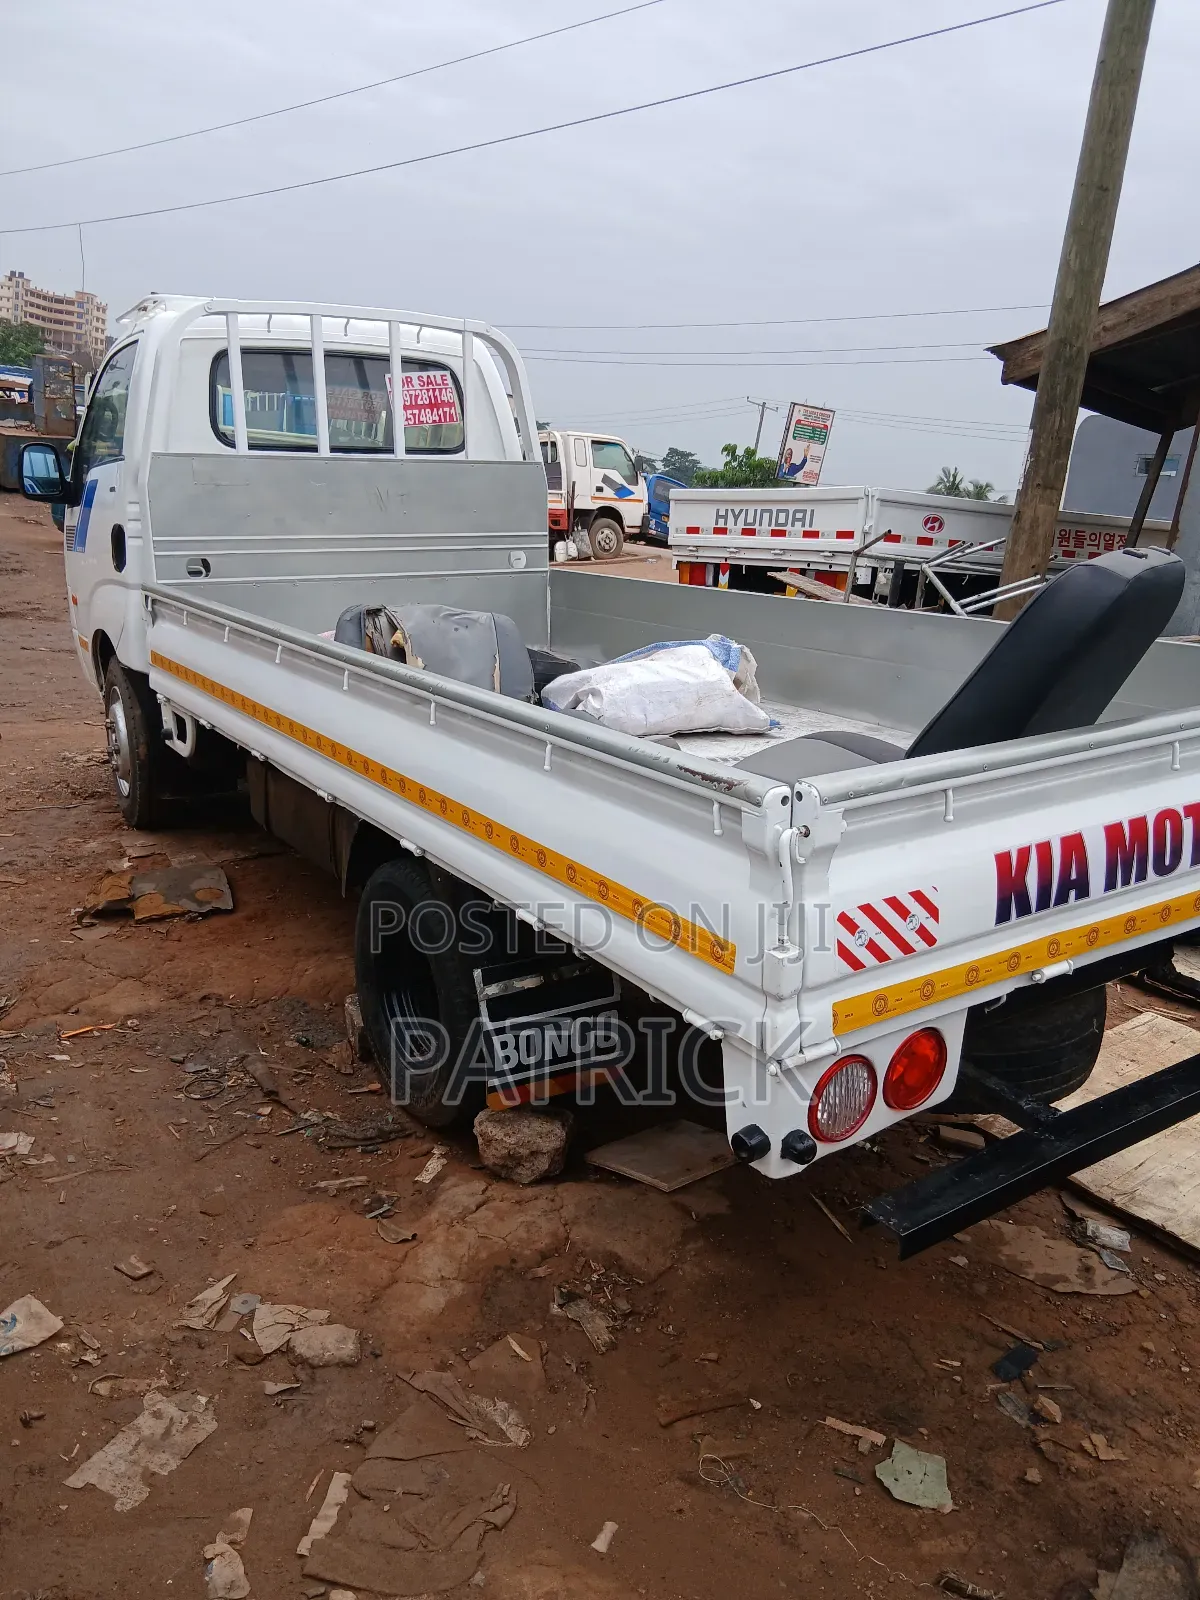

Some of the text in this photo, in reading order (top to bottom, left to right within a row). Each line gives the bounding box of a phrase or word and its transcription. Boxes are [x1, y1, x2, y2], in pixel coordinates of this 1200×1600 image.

[417, 374, 449, 388] SALE
[402, 388, 454, 406] 97281146
[714, 508, 815, 528] HYUNDAI
[994, 831, 1091, 926] KIA
[493, 1010, 619, 1072] BONGO
